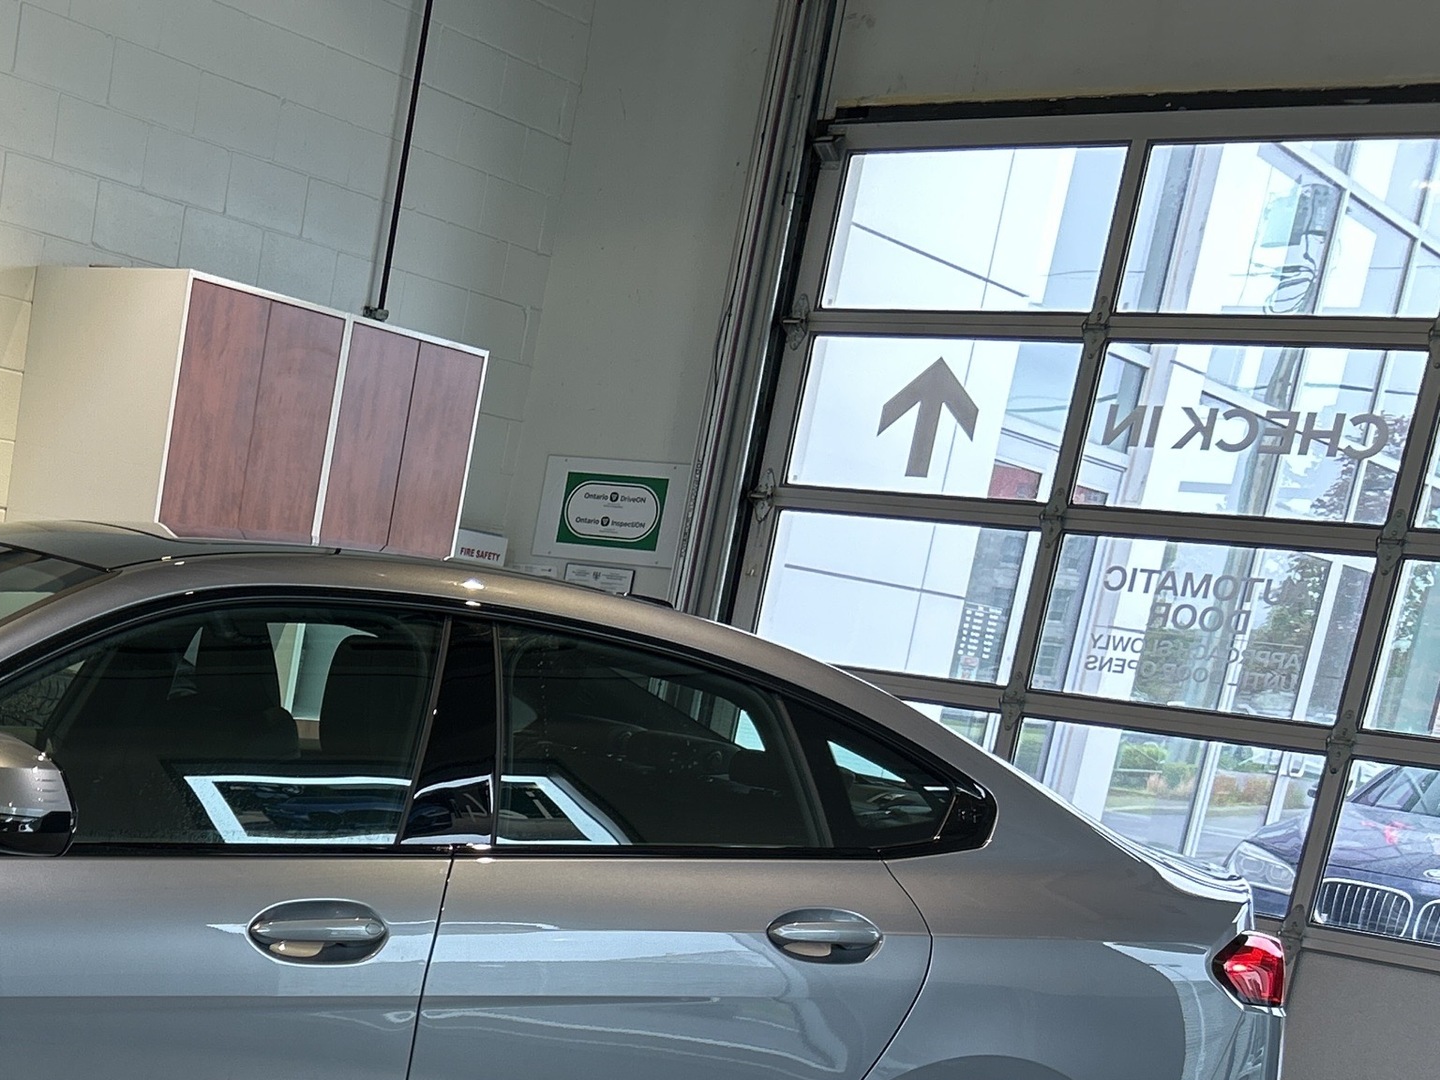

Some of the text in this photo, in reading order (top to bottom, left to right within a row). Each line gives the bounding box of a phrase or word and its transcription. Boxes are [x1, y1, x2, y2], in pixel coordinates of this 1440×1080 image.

[584, 492, 609, 501] Ontario
[575, 516, 600, 525] Ontario
[460, 547, 501, 561] FIRE SAFETY
